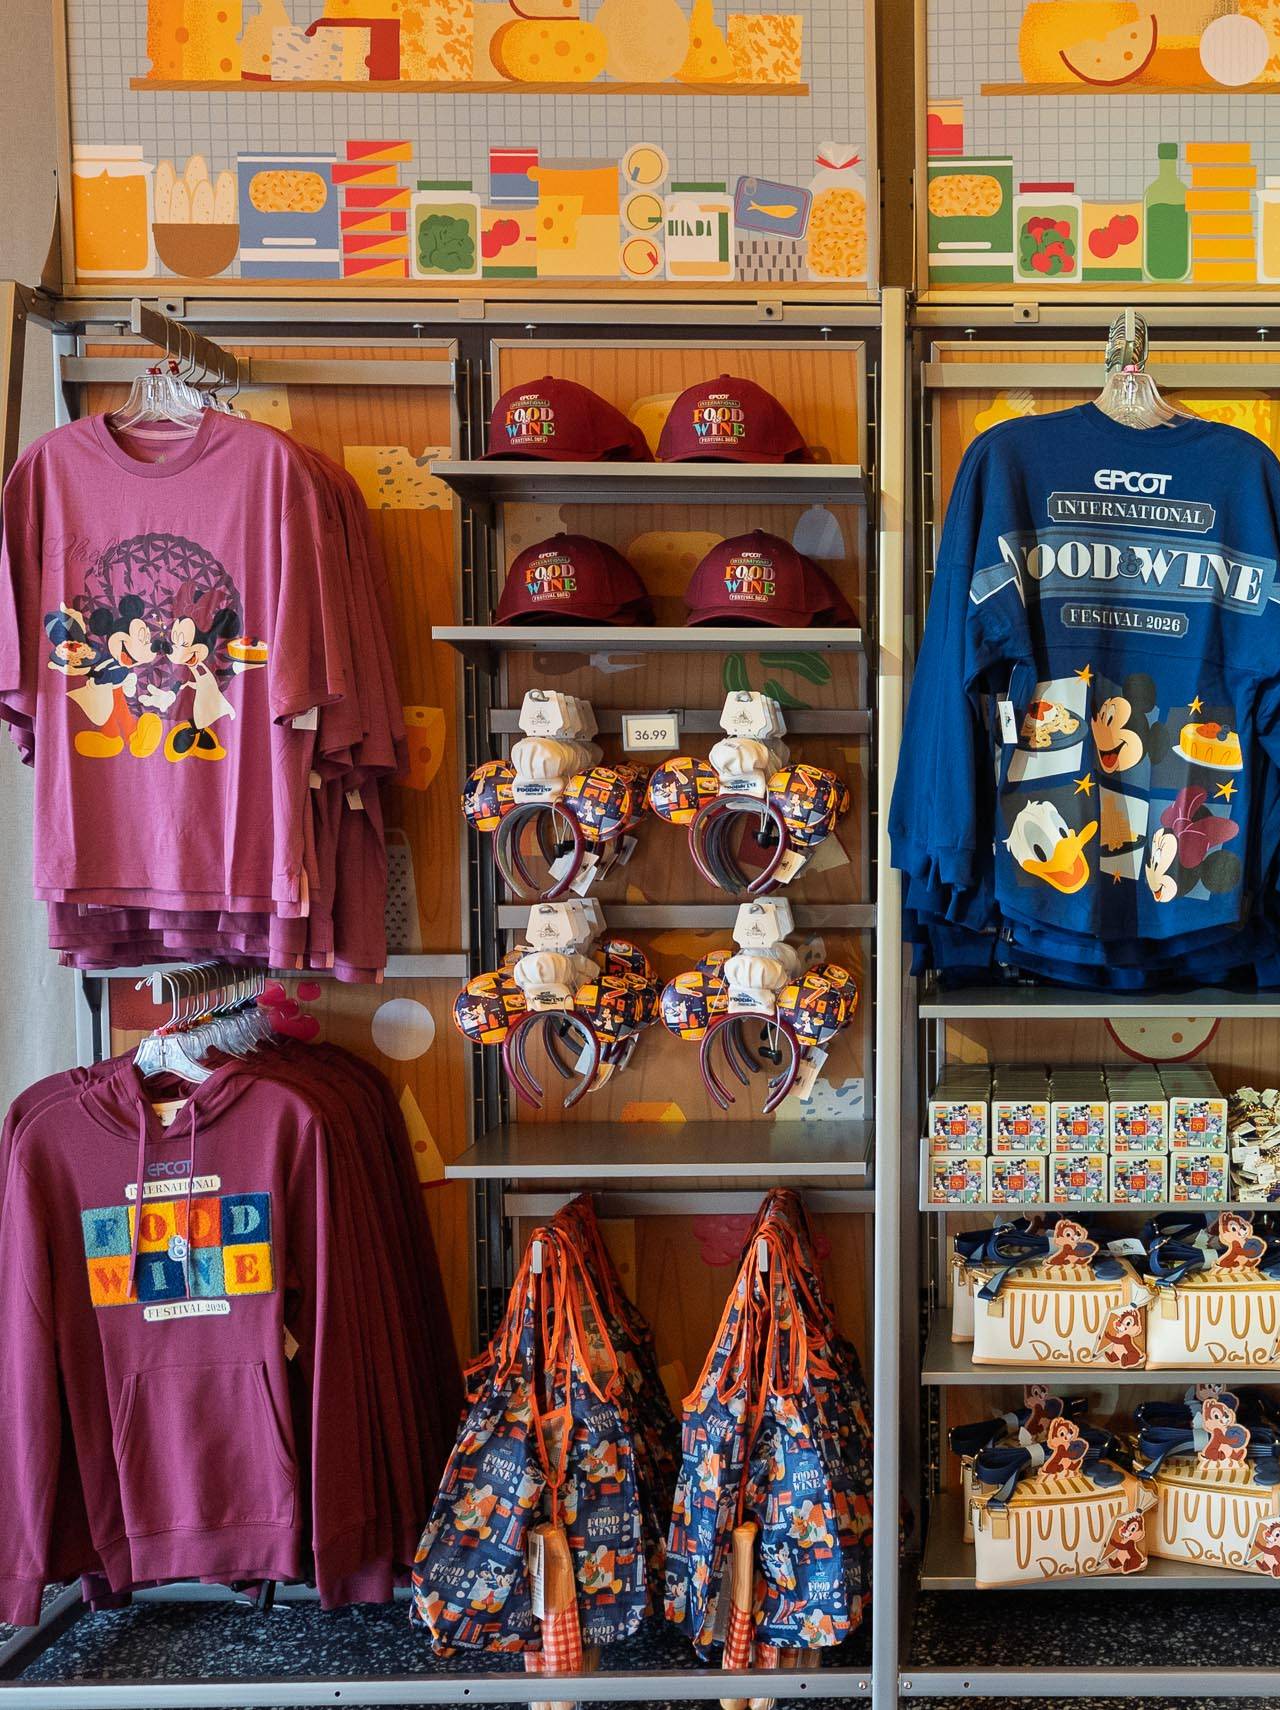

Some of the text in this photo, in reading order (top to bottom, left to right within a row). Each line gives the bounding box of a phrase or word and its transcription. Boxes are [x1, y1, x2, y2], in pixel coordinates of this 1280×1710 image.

[506, 407, 554, 424] FOOD
[692, 407, 745, 423] FOOD
[506, 422, 555, 438] WINE
[692, 422, 746, 437] WINE
[1094, 469, 1172, 495] EPCOT
[1057, 500, 1205, 525] INTERNATIONAL
[525, 564, 575, 583] FOOD
[724, 565, 776, 580] FOOD
[1020, 541, 1264, 604] OOD & WINE
[525, 578, 577, 595] WINE
[724, 579, 776, 595] WINE
[1070, 609, 1181, 632] FESTIVAL 2026
[634, 730, 667, 740] 36.99
[147, 1160, 193, 1177] EPCOT
[94, 1205, 261, 1249] FOOD
[148, 1302, 227, 1319] FESTIVAL 2026
[1029, 1339, 1094, 1365] Dale
[1204, 1341, 1269, 1366] Dale
[587, 1515, 620, 1528] FOOD
[587, 1526, 620, 1537] WINE
[1181, 1537, 1243, 1563] Dale
[1037, 1555, 1099, 1579] Dale
